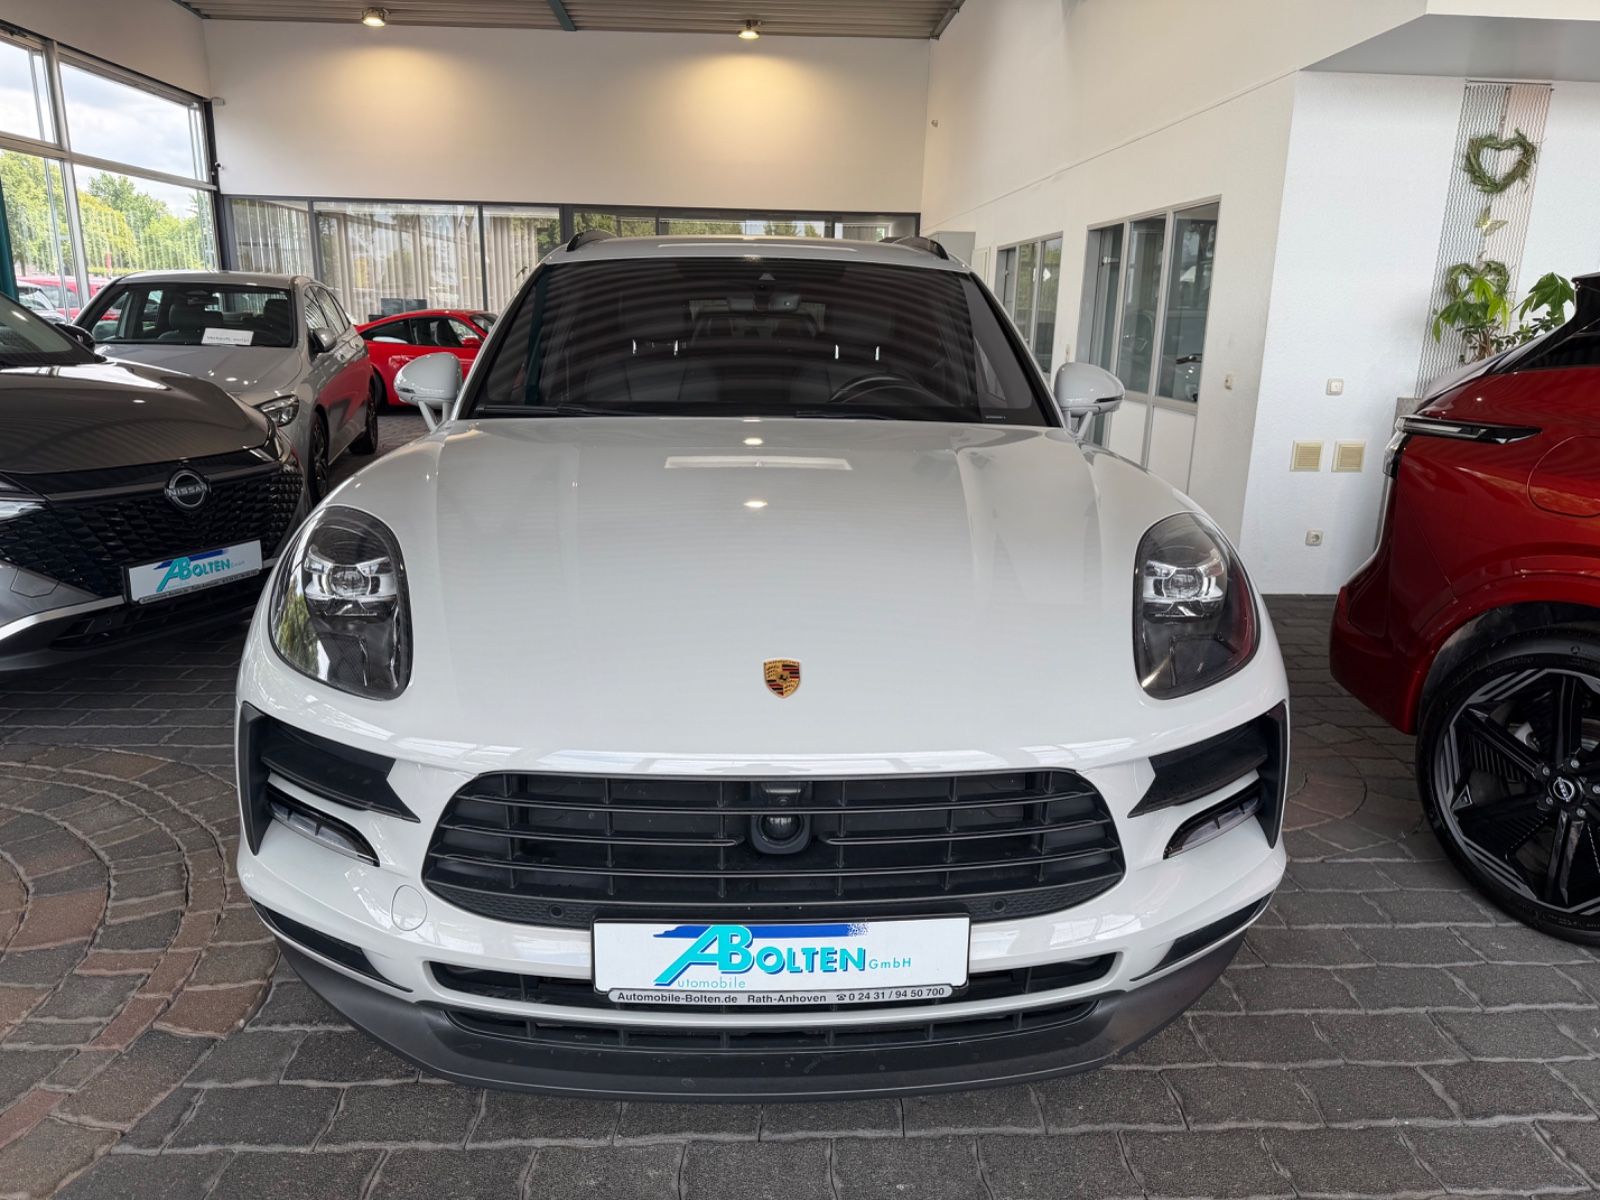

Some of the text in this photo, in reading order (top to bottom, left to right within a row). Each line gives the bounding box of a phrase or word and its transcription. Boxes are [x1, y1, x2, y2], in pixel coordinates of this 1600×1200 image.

[166, 484, 207, 497] NISSAN
[869, 957, 911, 969] GmbH
[617, 992, 738, 1003] Automobile-Bolten.de
[747, 994, 827, 1003] Rath-Anhoven
[857, 992, 870, 1000] 24
[873, 991, 886, 1000] 31
[895, 989, 907, 998] 94
[910, 988, 923, 997] 50
[926, 987, 945, 996] 700
